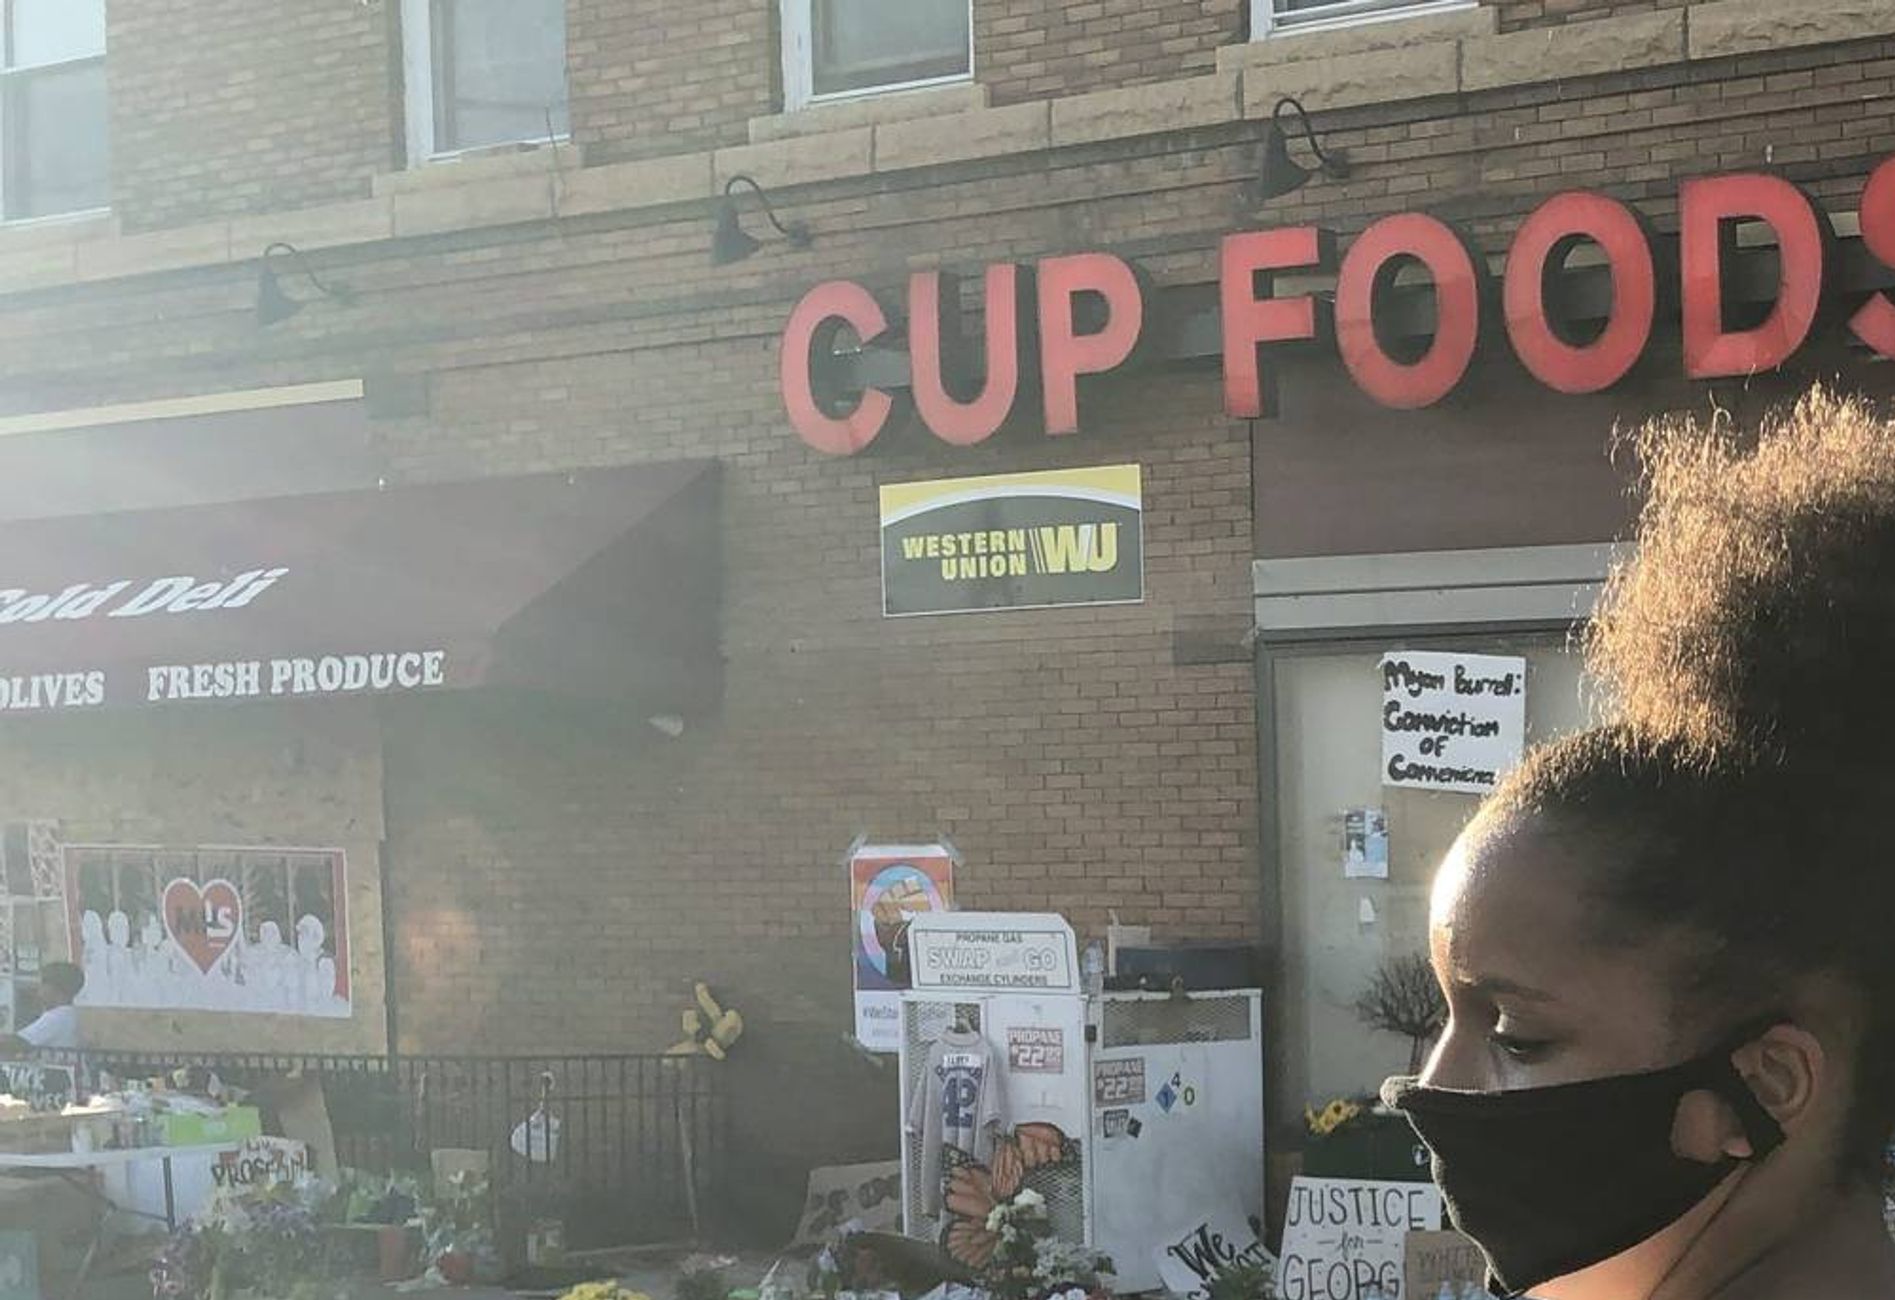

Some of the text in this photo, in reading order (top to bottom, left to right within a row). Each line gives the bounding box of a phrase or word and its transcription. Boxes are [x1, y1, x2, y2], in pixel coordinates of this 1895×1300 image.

[780, 252, 1143, 456] CUP
[903, 529, 1026, 559] WESTERN
[1041, 521, 1119, 574] WU
[941, 553, 1027, 580] UNION
[108, 568, 289, 617] Deli
[147, 650, 445, 701] FRESH PRODUCE
[1384, 700, 1500, 737] Conviction
[926, 947, 991, 970] SWAP
[1008, 1029, 1062, 1045] PROPANE
[1171, 1071, 1181, 1089] 4
[1288, 1186, 1425, 1231] JUSTICE
[1337, 1230, 1366, 1257] for
